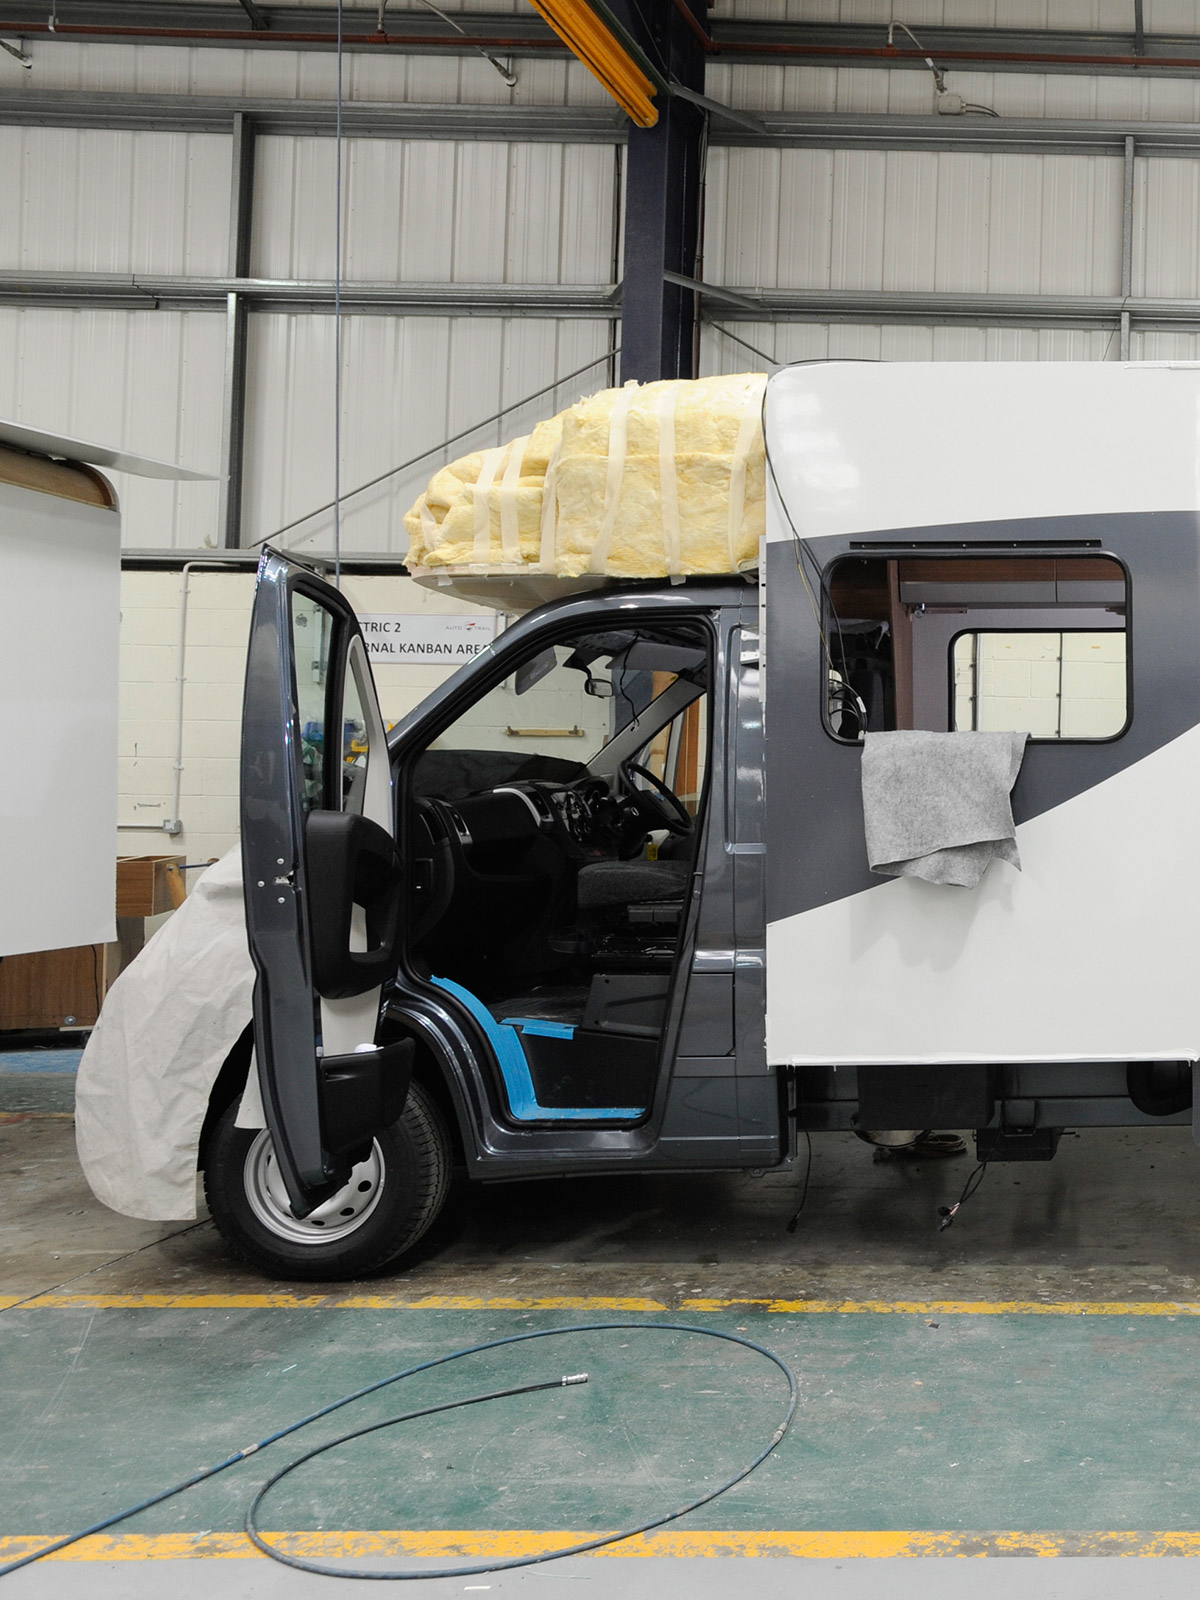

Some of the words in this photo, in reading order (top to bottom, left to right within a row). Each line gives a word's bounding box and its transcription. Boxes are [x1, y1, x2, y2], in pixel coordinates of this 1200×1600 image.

[358, 621, 390, 633] TRIC
[394, 622, 401, 633] 2
[399, 643, 452, 654] KANBAN
